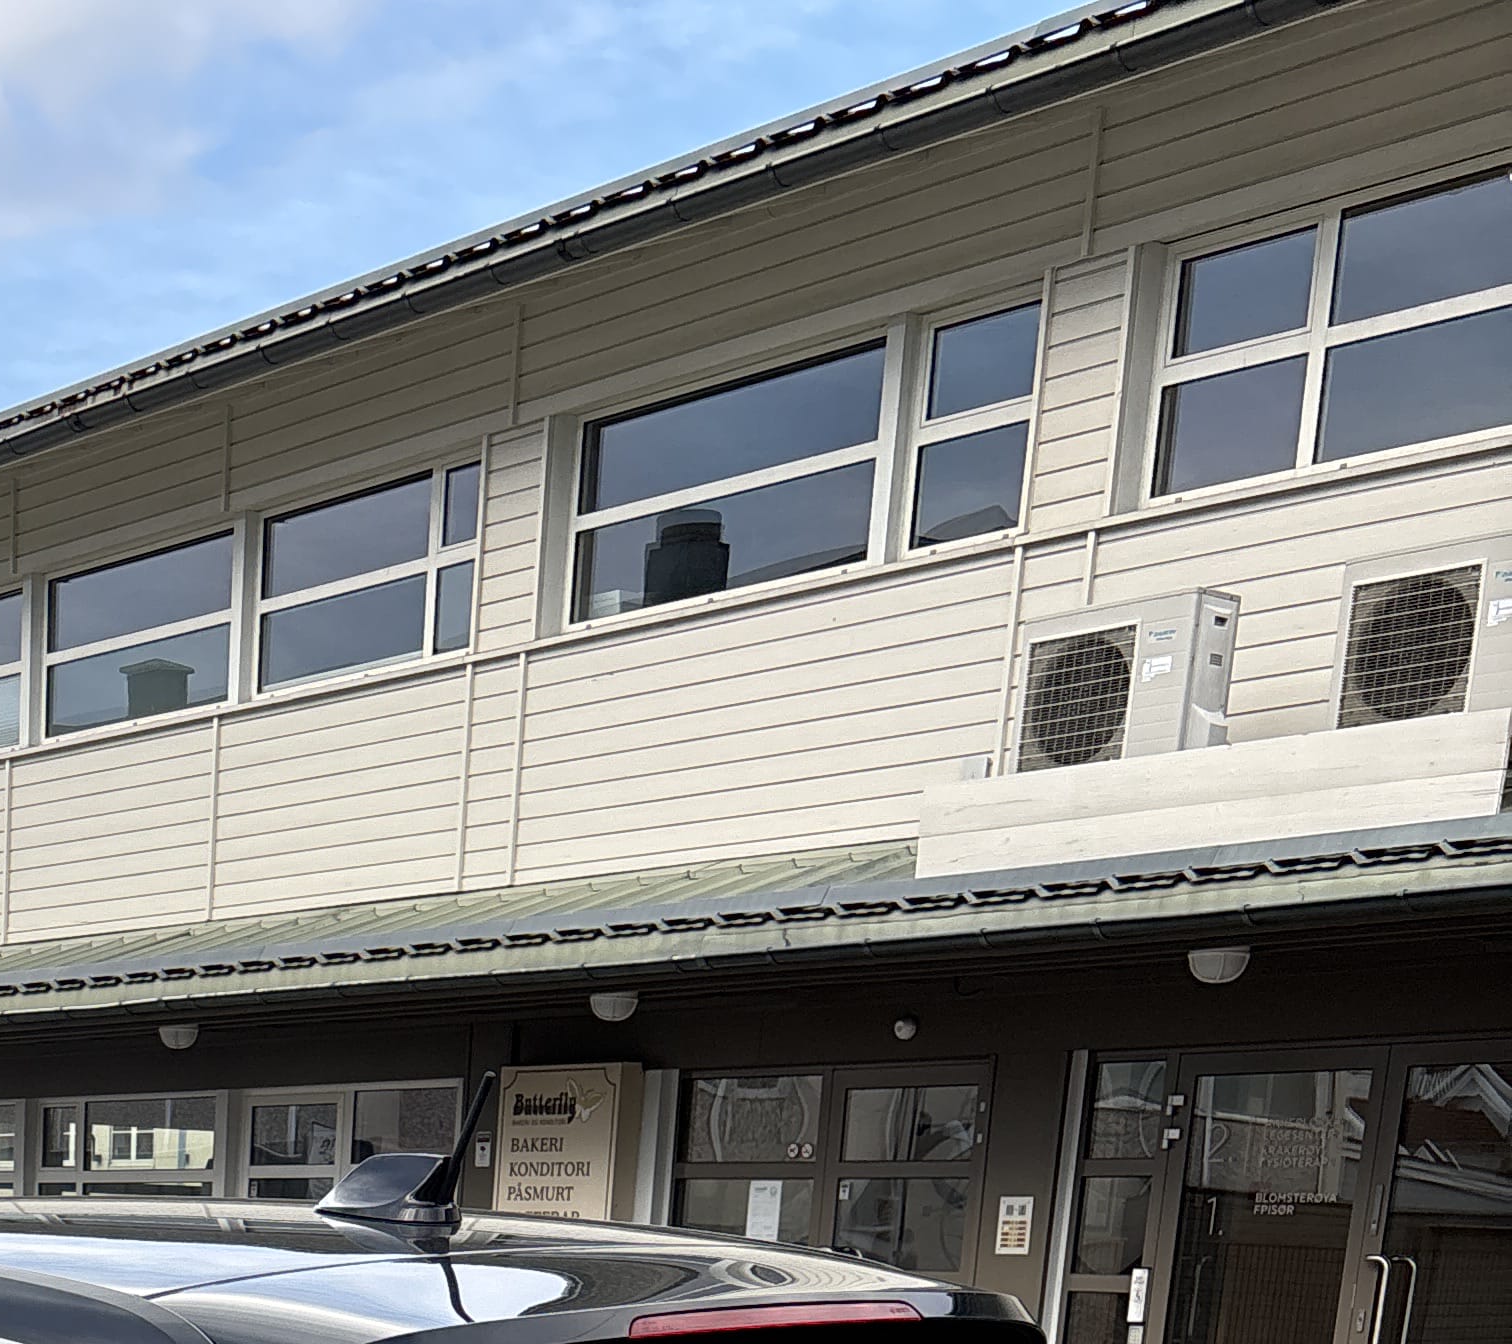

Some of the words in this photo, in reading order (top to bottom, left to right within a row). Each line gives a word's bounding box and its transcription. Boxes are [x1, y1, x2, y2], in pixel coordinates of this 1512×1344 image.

[513, 1092, 577, 1124] Butterfly
[510, 1137, 564, 1152] BAKERI
[509, 1162, 591, 1177] KONDITORI
[506, 1182, 575, 1201] PÅSMURT
